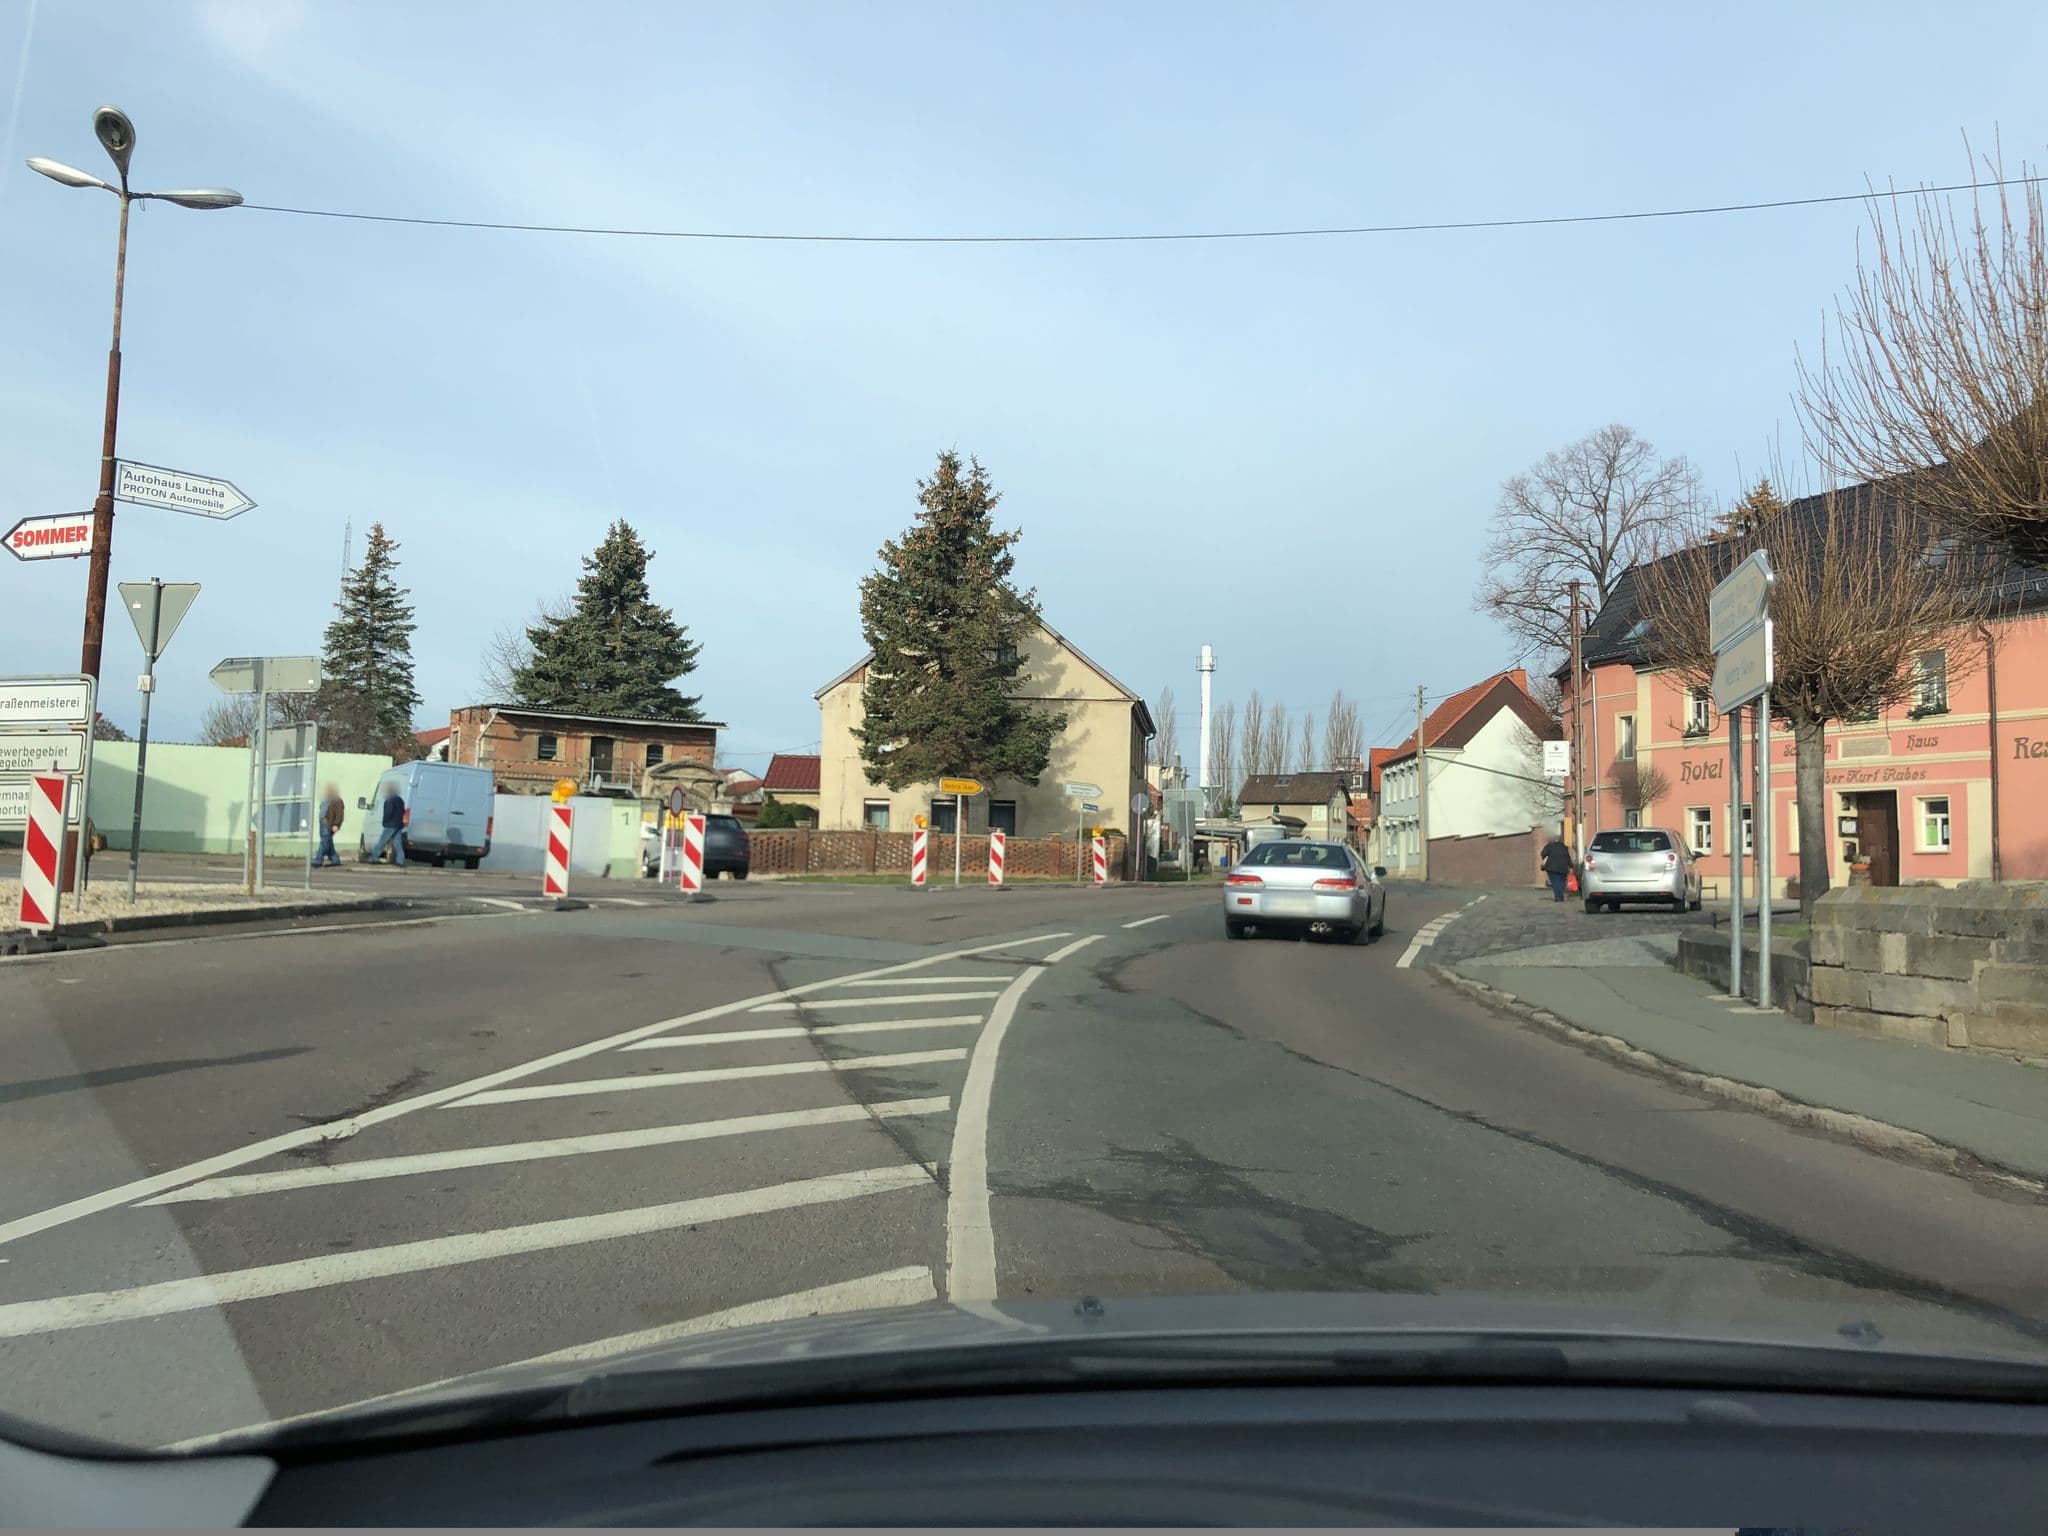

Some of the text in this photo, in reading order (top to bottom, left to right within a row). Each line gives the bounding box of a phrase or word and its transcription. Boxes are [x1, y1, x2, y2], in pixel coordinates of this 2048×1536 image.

[125, 470, 225, 498] Autohaus Laucha
[123, 483, 224, 510] PROTON Automobile
[13, 525, 88, 548] SOMMER
[0, 696, 80, 709] raßenmeisterei
[1906, 735, 1939, 751] Haus
[0, 746, 68, 760] ewerbegebiet
[0, 756, 33, 769] egeloh
[1680, 758, 1724, 784] Hotel
